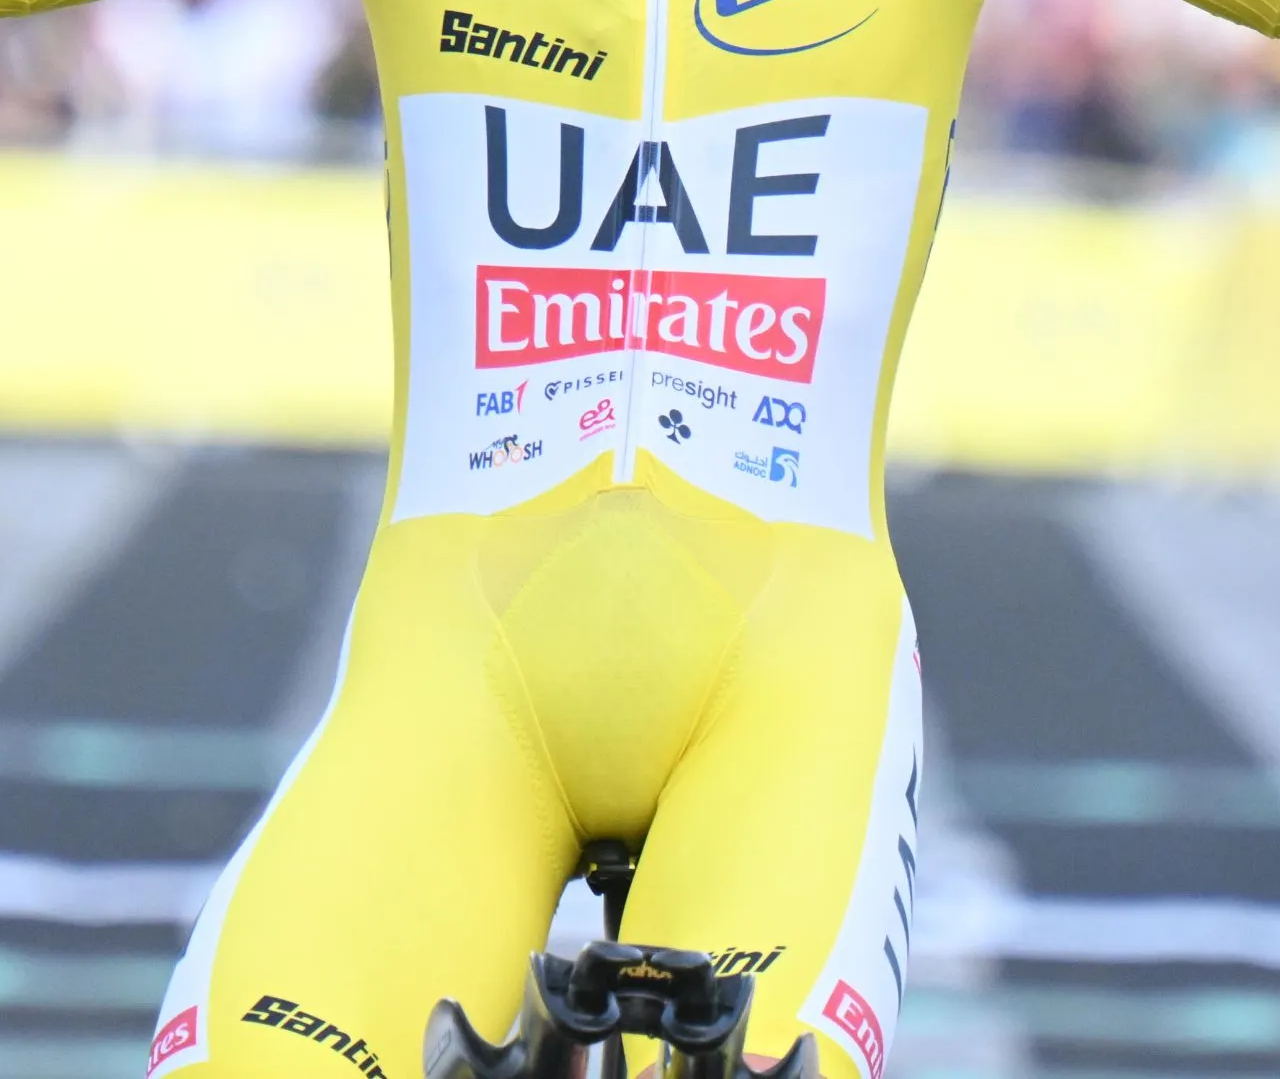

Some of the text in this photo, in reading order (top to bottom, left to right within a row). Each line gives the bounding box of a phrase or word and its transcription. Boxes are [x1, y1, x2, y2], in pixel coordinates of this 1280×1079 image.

[440, 9, 608, 81] Santini
[484, 104, 832, 257] UAE
[484, 277, 812, 365] Emirates
[563, 370, 624, 394] PISSEI
[651, 371, 738, 410] presight
[733, 461, 767, 479] ADNOC
